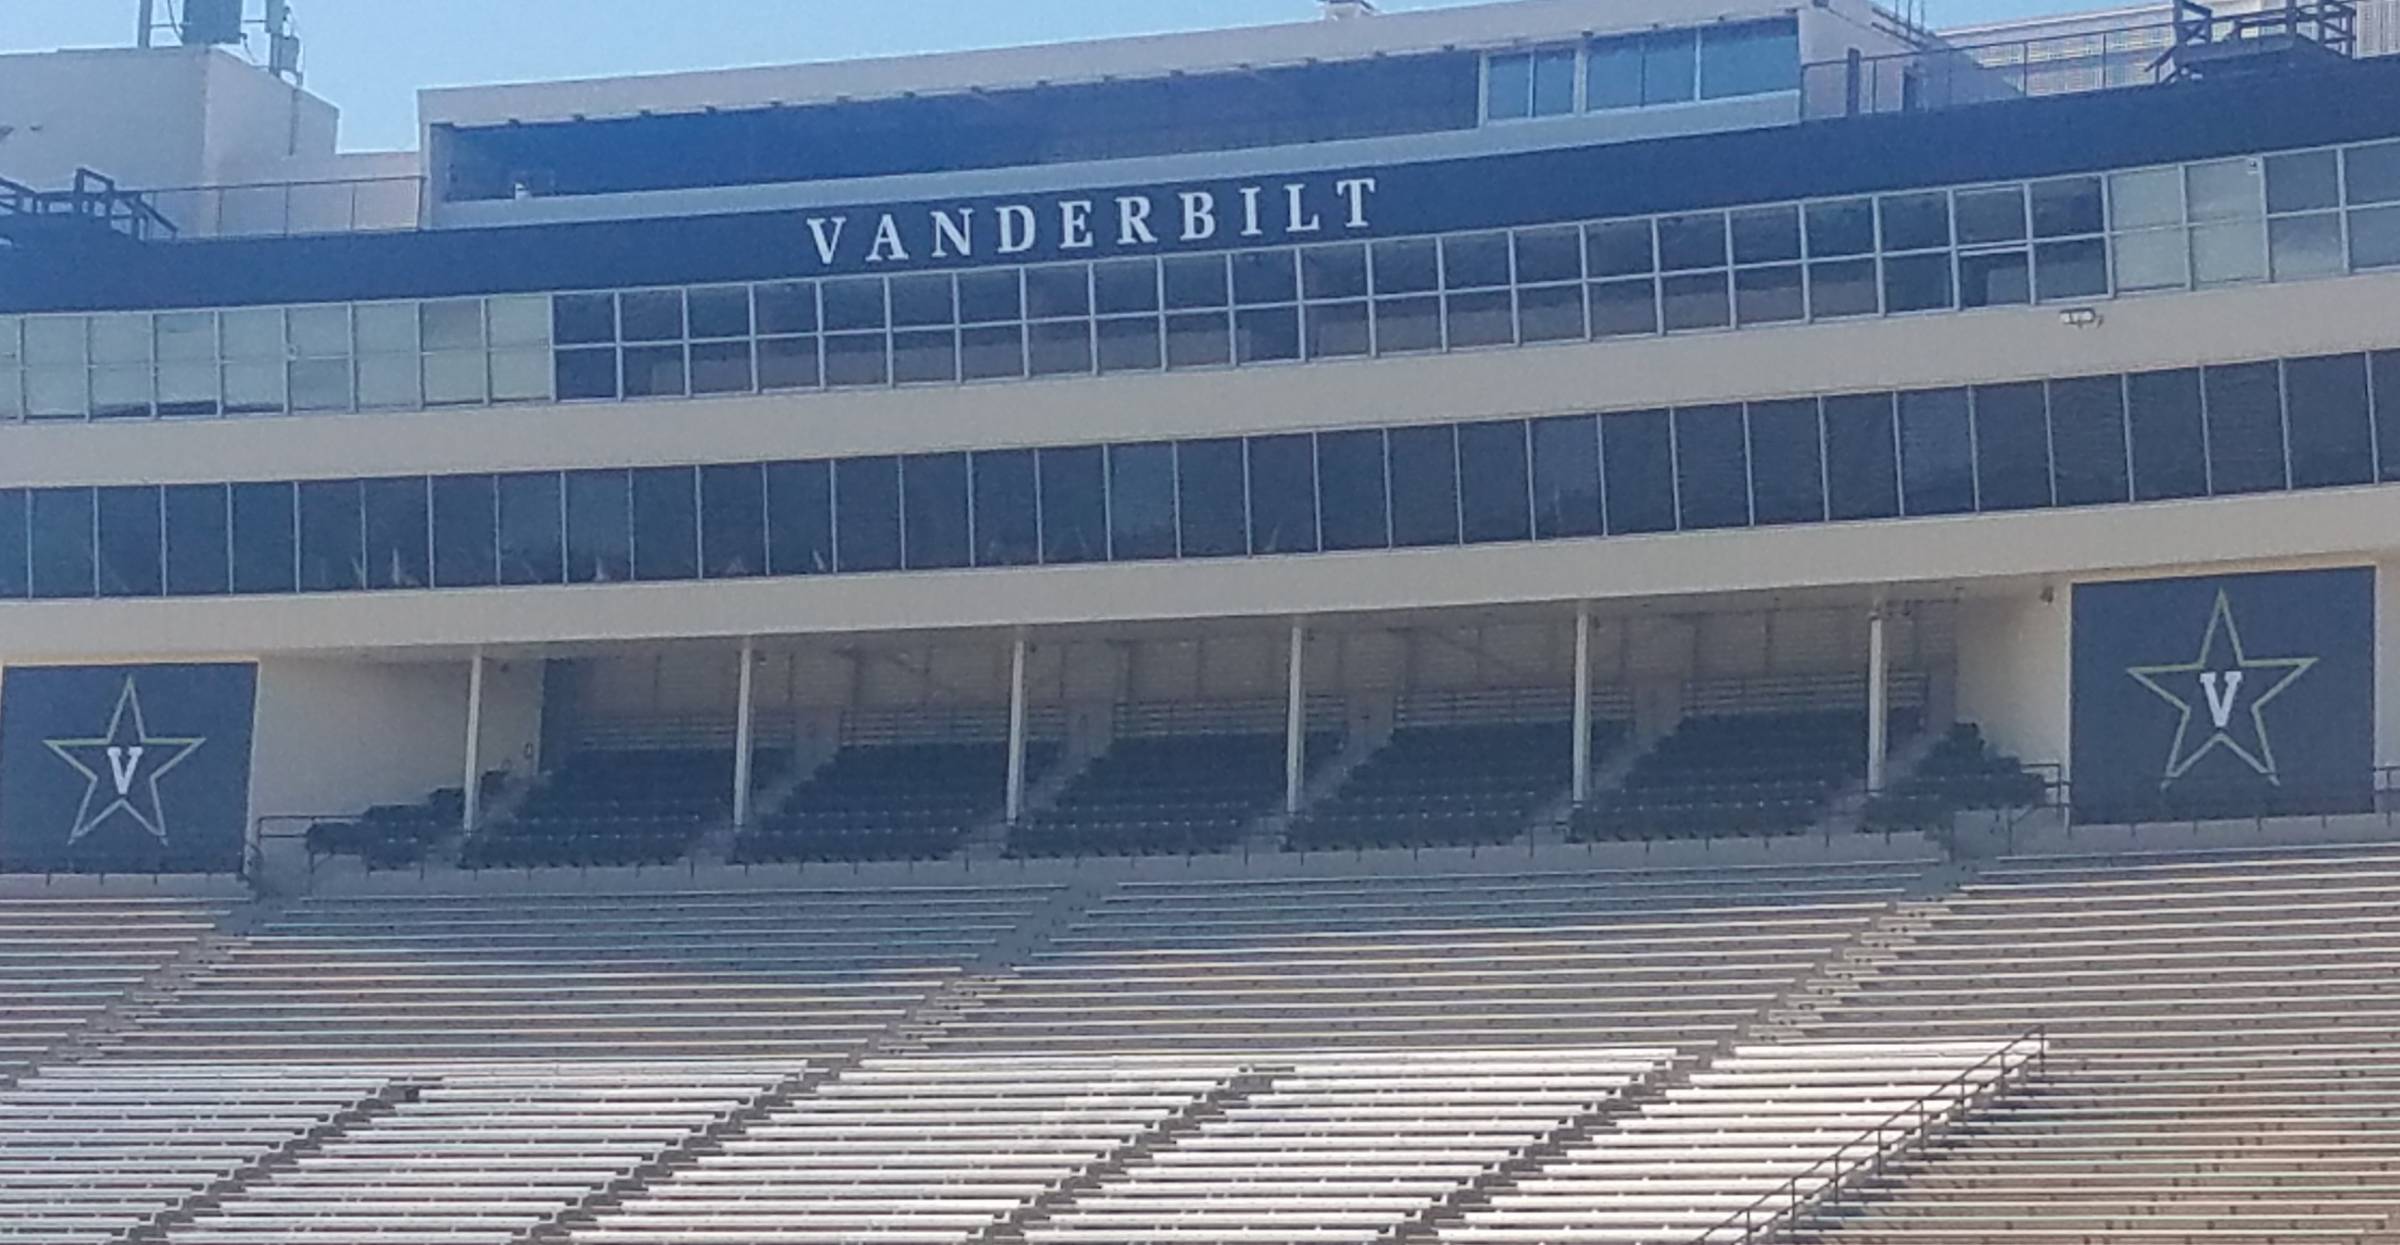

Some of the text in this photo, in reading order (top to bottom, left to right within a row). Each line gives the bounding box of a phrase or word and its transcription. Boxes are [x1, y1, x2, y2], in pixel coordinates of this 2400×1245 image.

[806, 178, 1376, 265] VANDERBILT
[2199, 670, 2243, 728] V
[107, 746, 143, 795] V
